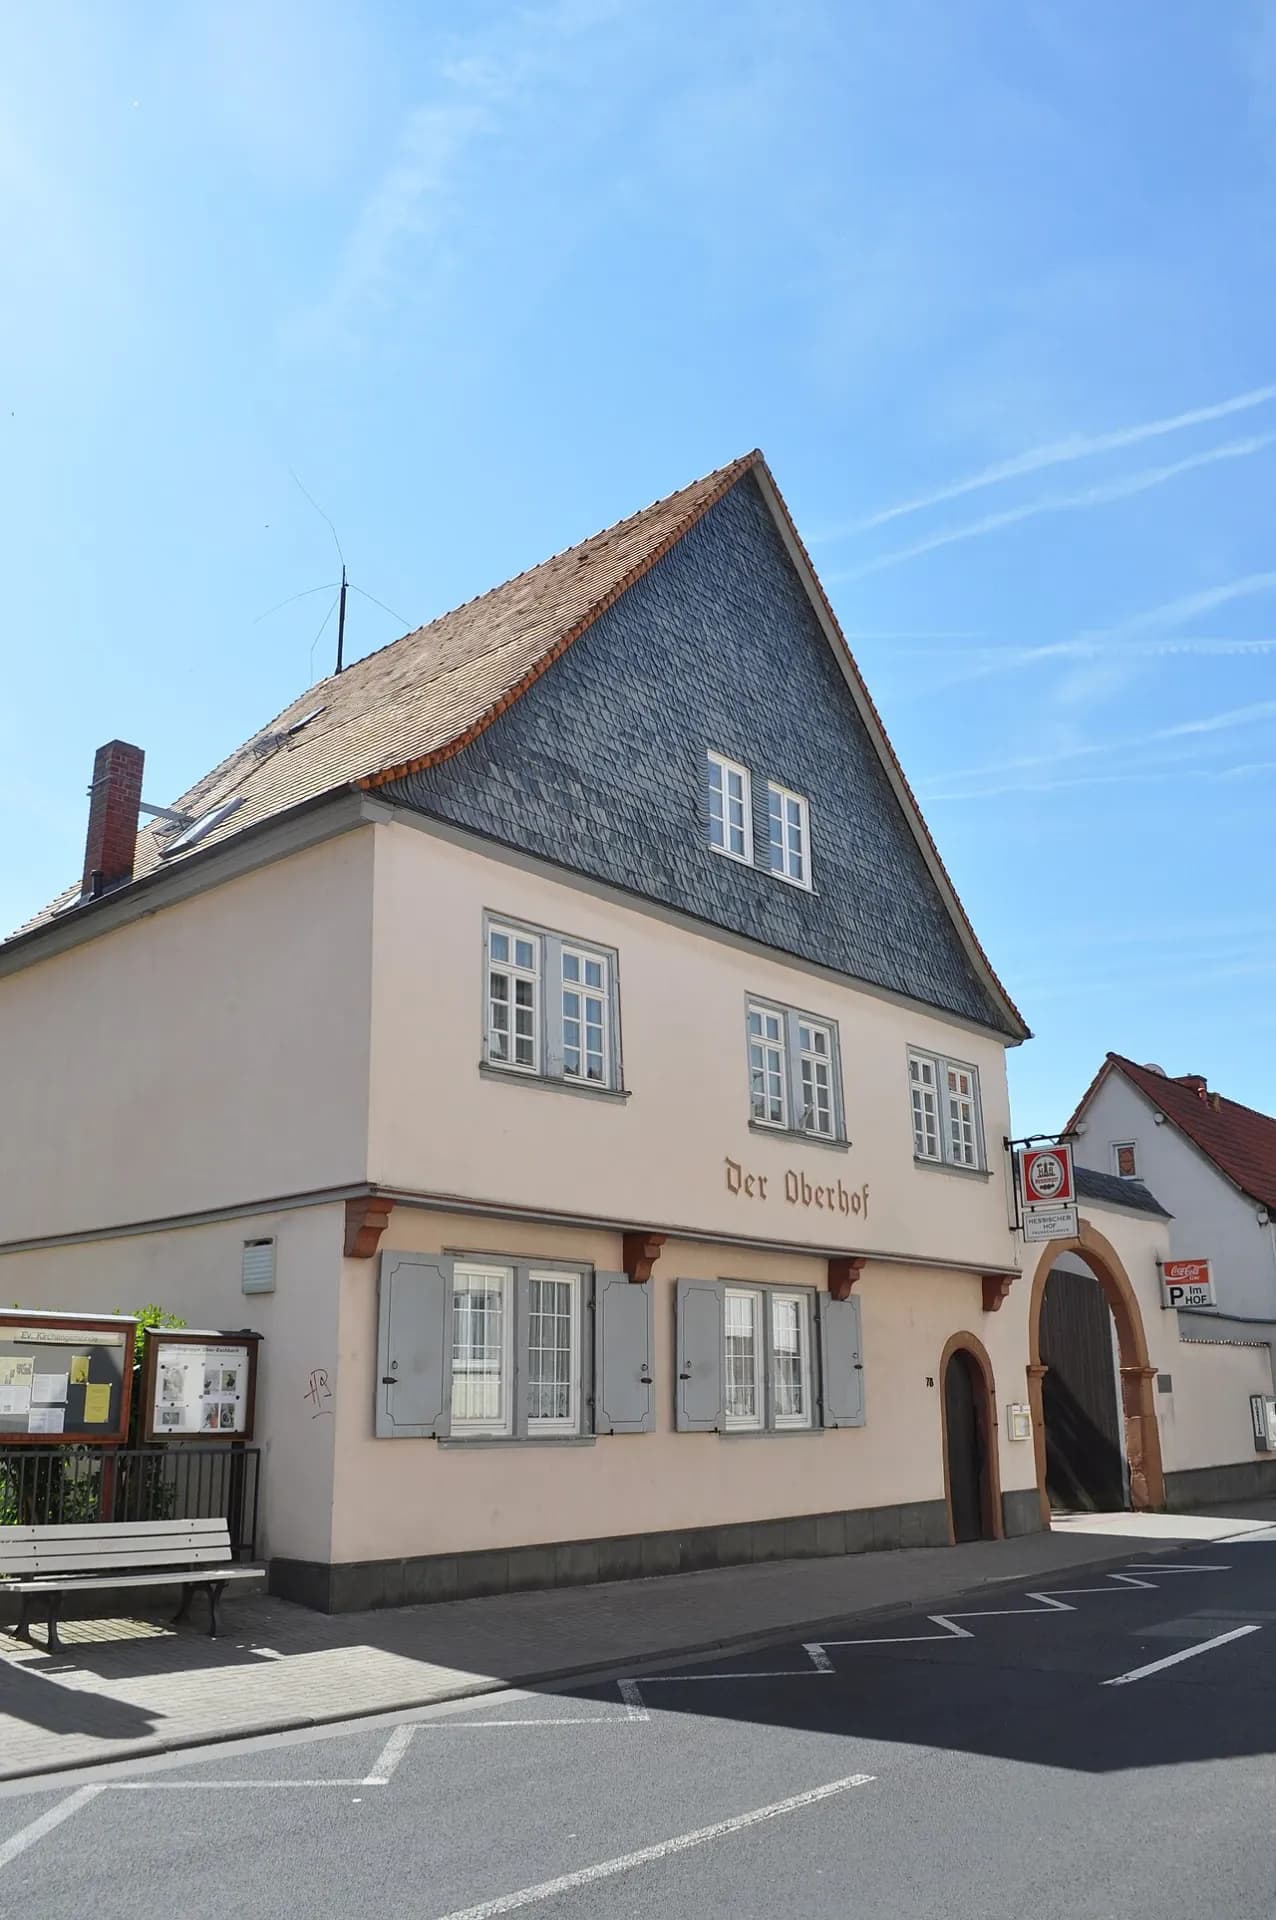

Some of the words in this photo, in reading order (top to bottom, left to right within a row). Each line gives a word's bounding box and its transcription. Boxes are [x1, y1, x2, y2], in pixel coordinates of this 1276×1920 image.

[725, 1156, 768, 1200] Der
[785, 1169, 869, 1221] Oberhof
[1028, 1215, 1072, 1225] HESSISCHER
[1169, 1287, 1184, 1305] P
[1185, 1295, 1208, 1305] HOF
